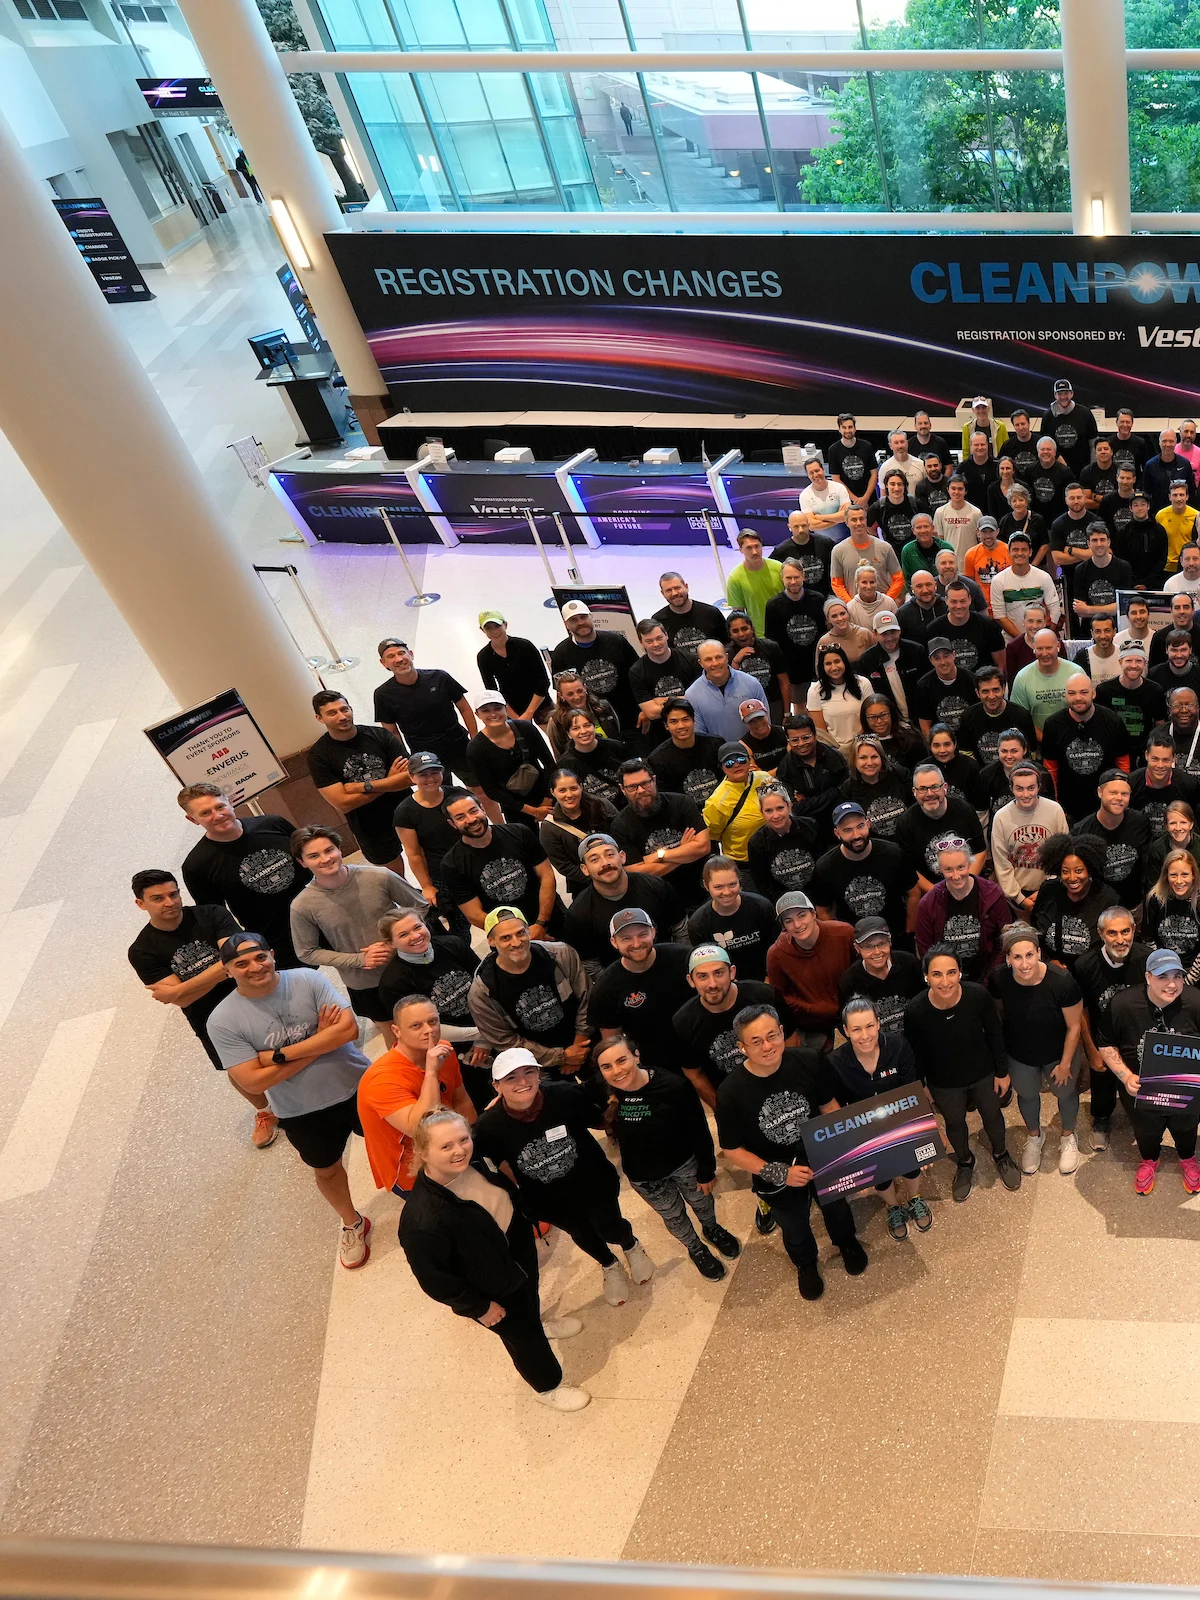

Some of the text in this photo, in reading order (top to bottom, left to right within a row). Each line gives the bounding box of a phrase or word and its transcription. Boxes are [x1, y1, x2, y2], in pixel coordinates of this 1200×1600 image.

[374, 268, 783, 298] REGISTRATION CHANGES
[957, 330, 1126, 342] REGISTRATION SPONSORED BY:
[158, 709, 212, 740] CLEANPOWER
[186, 730, 240, 760] EVENT SPONSORS
[188, 727, 232, 752] THANK YOU TO
[212, 747, 230, 761] ABB
[207, 750, 249, 776] ENVERUS
[236, 772, 257, 785] RADIA
[870, 807, 905, 822] CLEANPOWER
[248, 856, 289, 883] CLEANPOWER
[776, 862, 812, 875] CLEANPOWER
[486, 870, 523, 890] CLEANPOWER
[849, 890, 882, 902] CLEANPOWER
[726, 931, 761, 947] SCOUT
[618, 1110, 652, 1118] DAKOTA
[620, 1104, 652, 1112] NORTH
[765, 1106, 806, 1130] CLEANPOWER
[814, 1095, 919, 1142] CLEANPOWER
[524, 1144, 573, 1172] CLEANPOWER
[839, 1171, 864, 1182] POWERING
[828, 1179, 853, 1191] AMERICA'S
[838, 1183, 856, 1192] FUTURE
